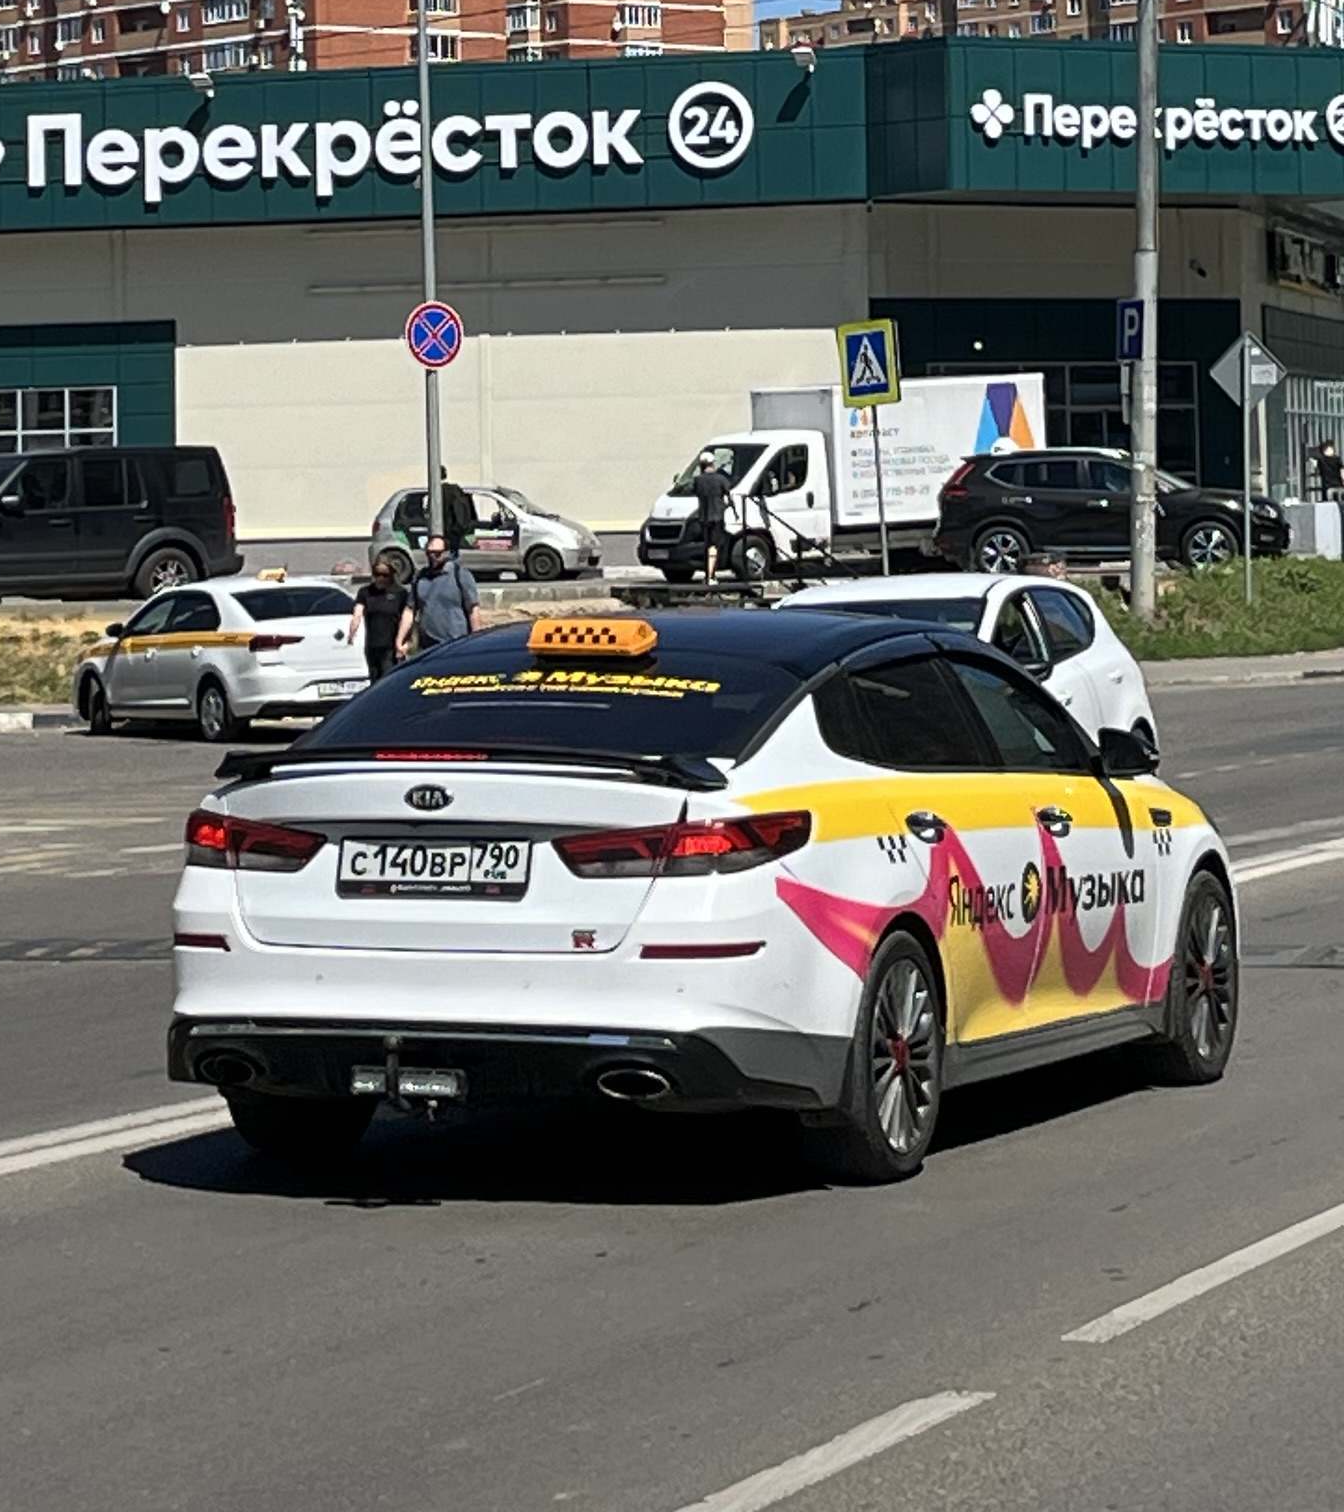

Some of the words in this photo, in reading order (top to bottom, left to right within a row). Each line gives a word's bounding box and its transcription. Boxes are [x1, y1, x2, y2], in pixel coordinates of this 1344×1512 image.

[26, 99, 644, 203] Перекрёсток
[682, 105, 740, 147] 24
[1023, 92, 1319, 151] Перерёсток
[412, 790, 444, 808] KIA
[475, 843, 520, 870] 790
[948, 874, 1016, 932] Яндекс
[1045, 865, 1145, 925] Музыка
